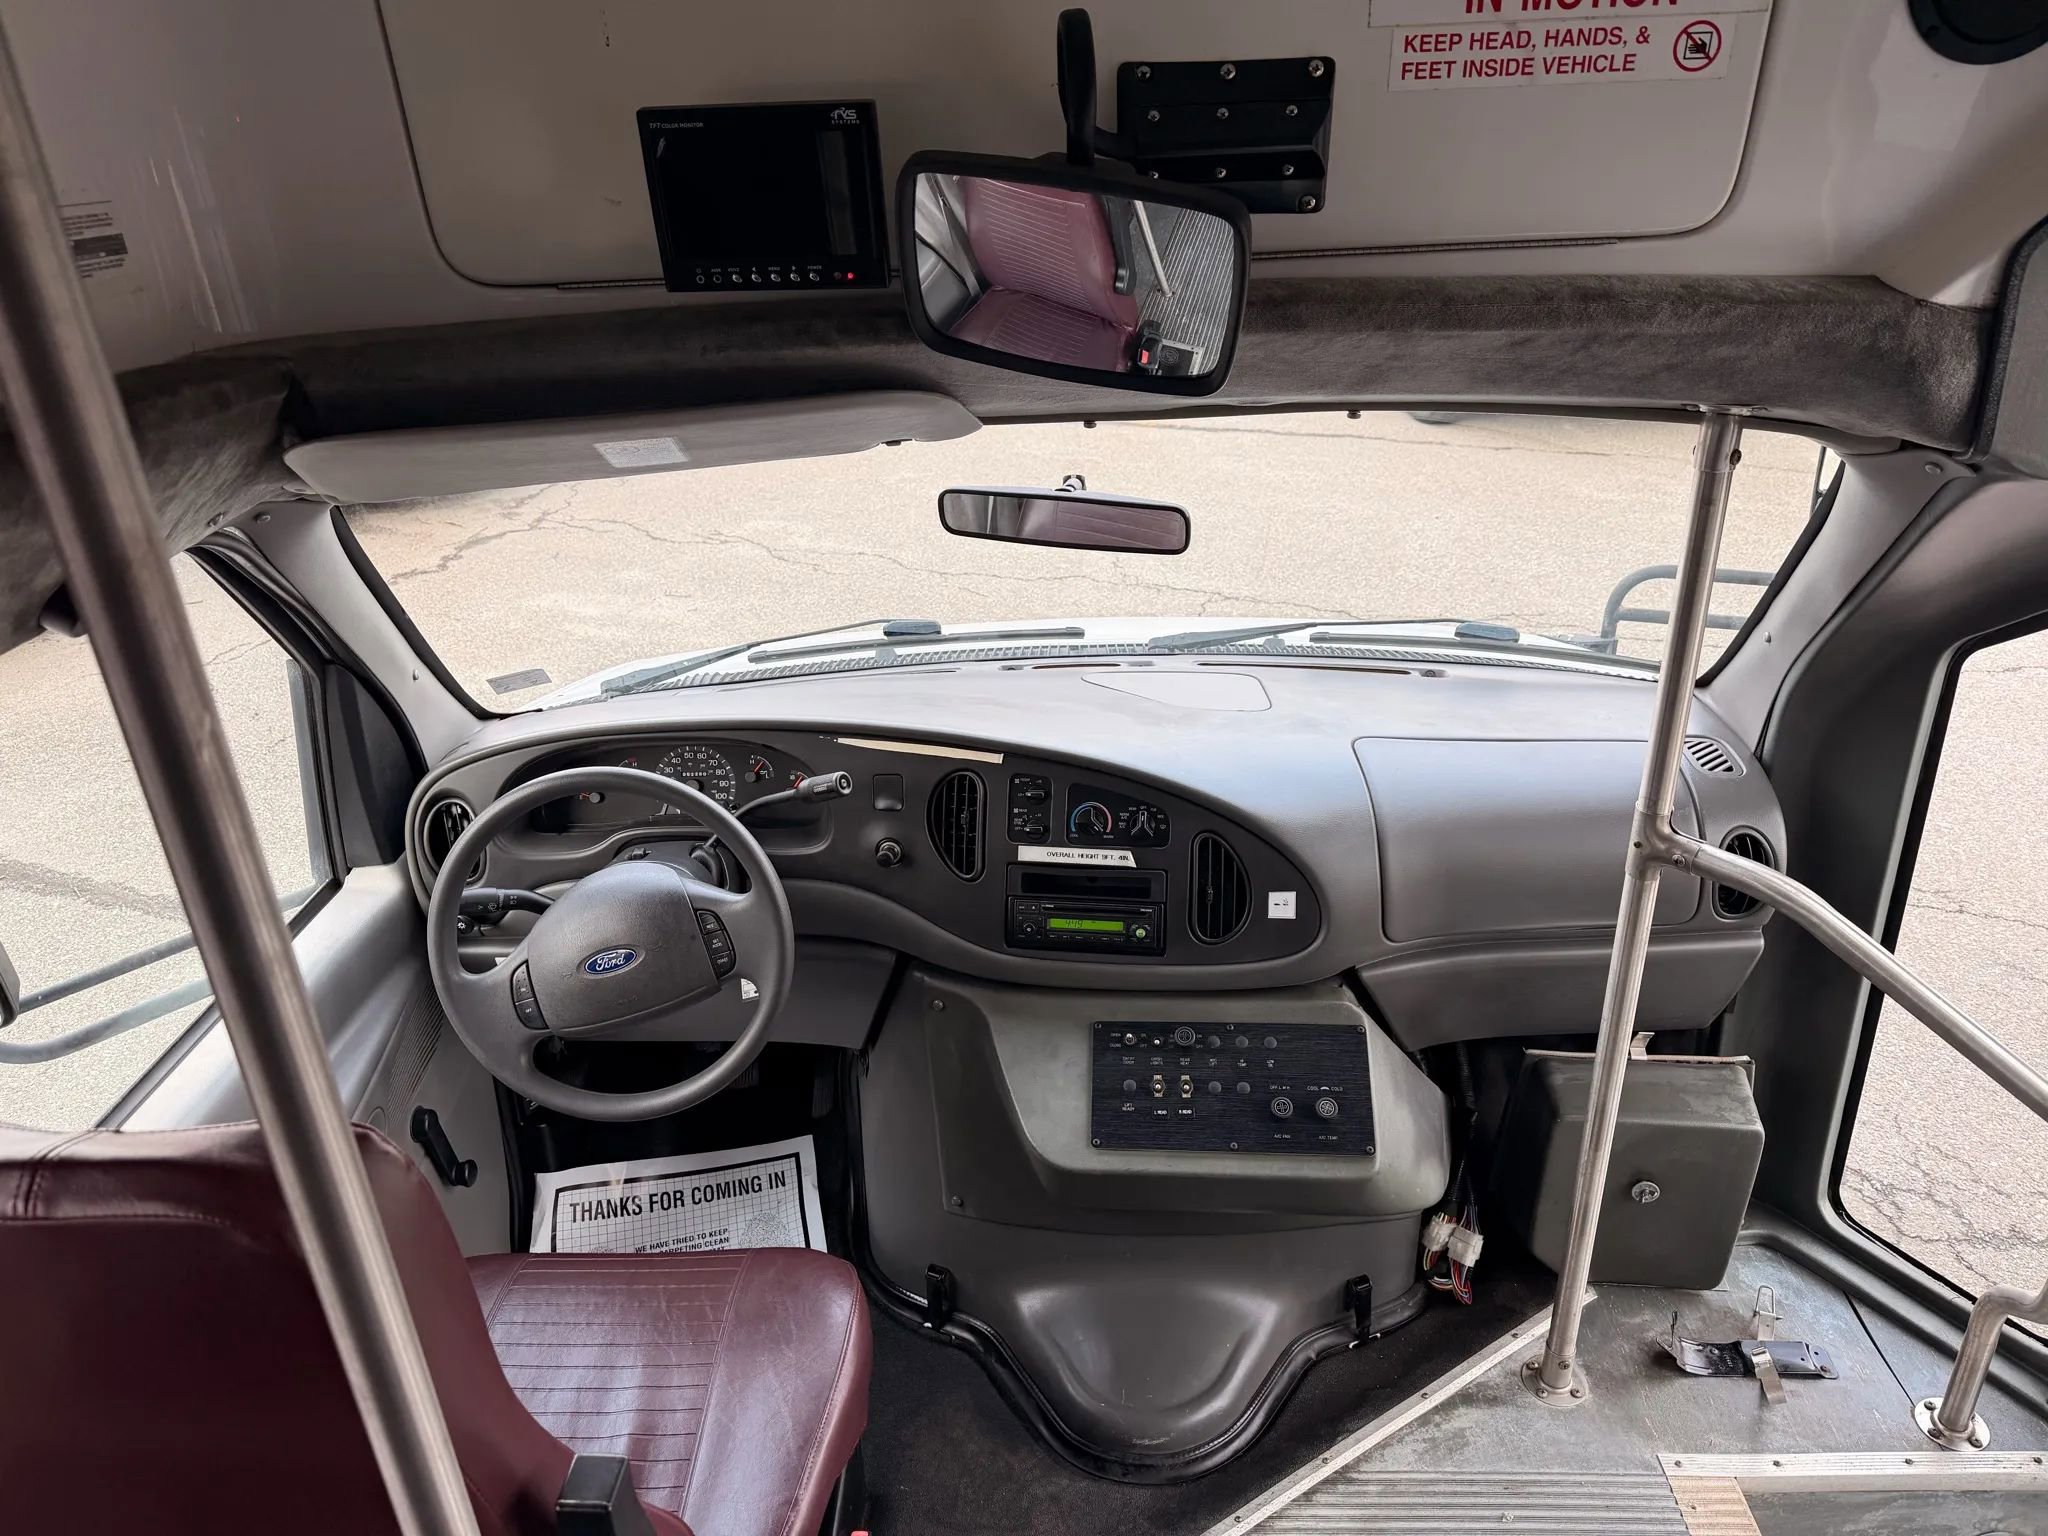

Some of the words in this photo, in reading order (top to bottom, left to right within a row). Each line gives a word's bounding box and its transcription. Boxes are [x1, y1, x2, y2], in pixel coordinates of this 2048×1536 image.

[1403, 33, 1463, 54] KEEP
[1469, 30, 1536, 52] HEAD,
[1544, 26, 1628, 48] HANDS,
[1635, 25, 1651, 45] &
[1401, 60, 1457, 80] FEET
[1462, 57, 1536, 78] INSIDE
[1542, 53, 1637, 75] VEHICLE
[714, 792, 728, 800] 100
[1046, 851, 1076, 859] OVERALL
[595, 952, 626, 971] Ford
[569, 1194, 643, 1223] THANKS
[649, 1189, 685, 1213] FOR
[691, 1175, 763, 1206] COMING
[768, 1170, 786, 1190] IN
[635, 1245, 648, 1253] WE
[649, 1240, 670, 1251] HAVE
[672, 1235, 695, 1246] TRIED
[697, 1232, 707, 1241] TO
[708, 1228, 728, 1238] KEEP
[704, 1236, 729, 1248] CLEAN
